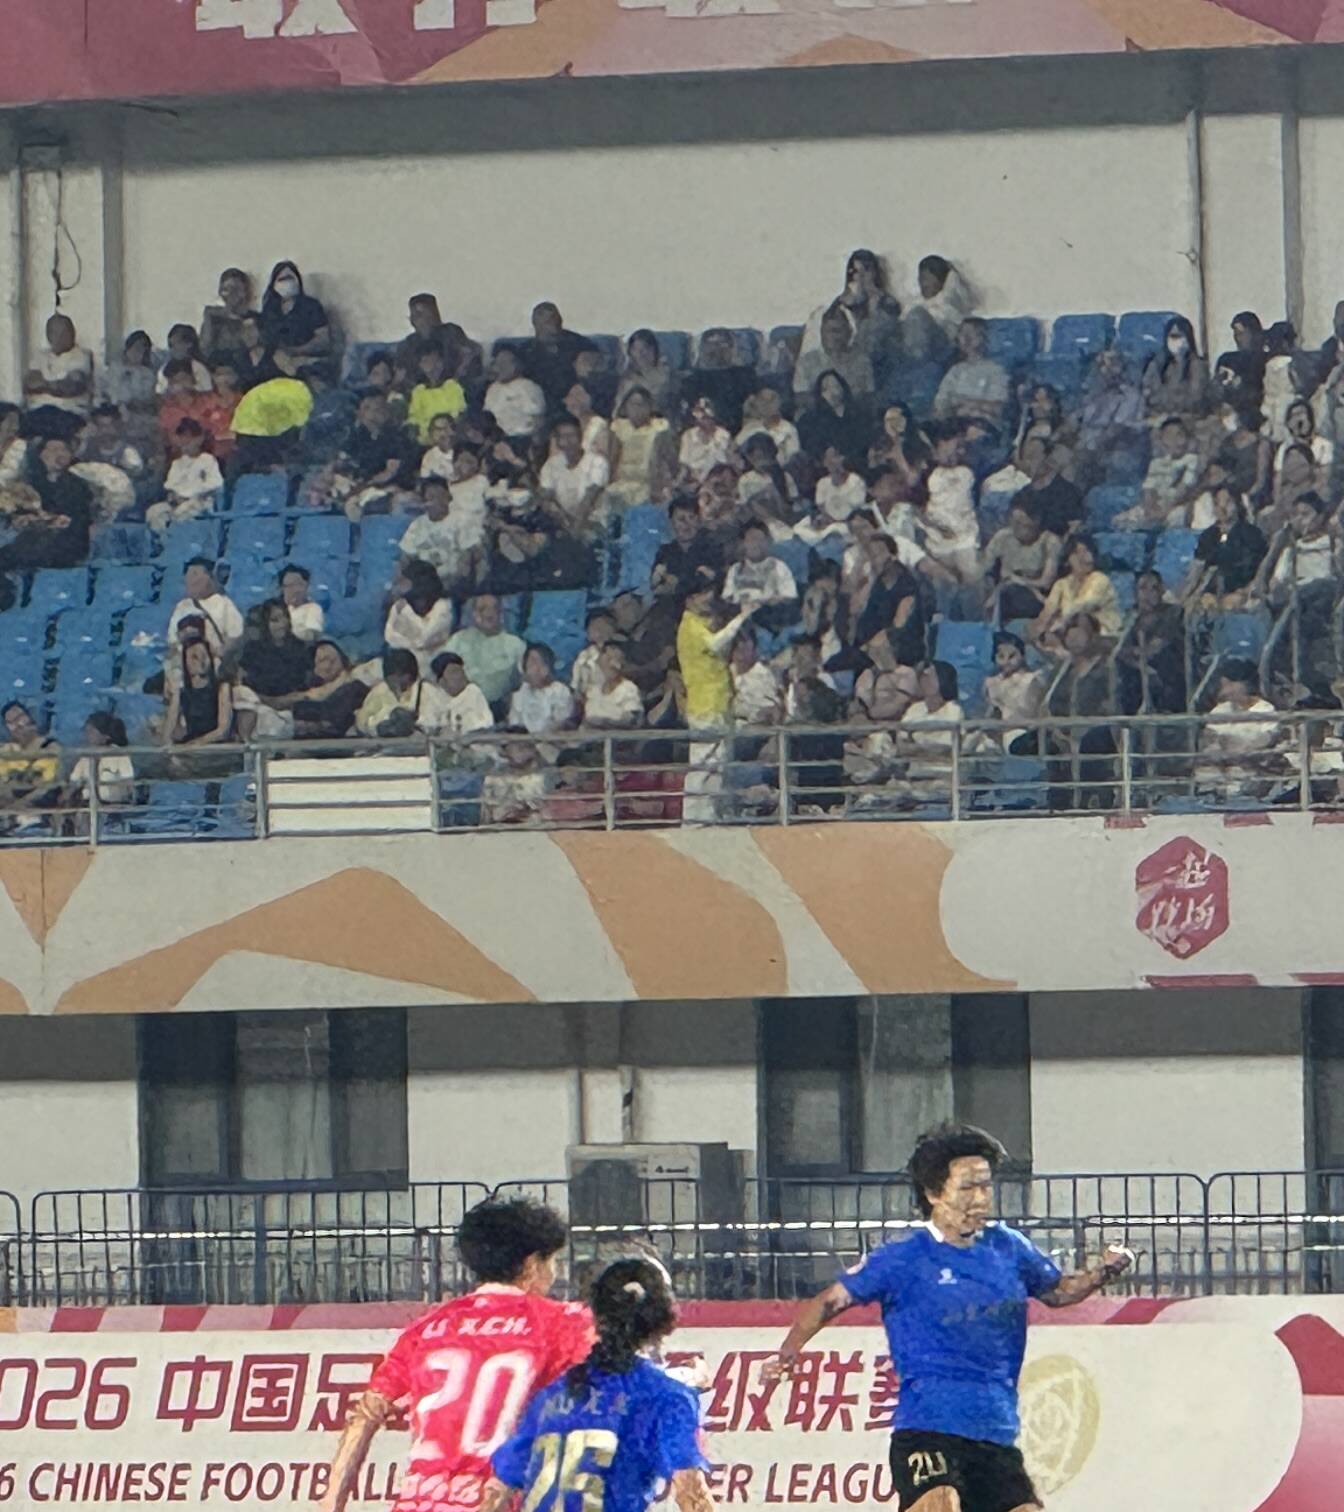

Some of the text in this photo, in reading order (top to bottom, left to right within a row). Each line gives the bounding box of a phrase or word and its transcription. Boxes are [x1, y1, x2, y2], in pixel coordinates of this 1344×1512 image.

[410, 1348, 535, 1460] 20
[29, 1462, 192, 1502] CHINESE
[201, 1462, 402, 1502] FOOTBLL
[765, 1463, 896, 1503] LEAGU
